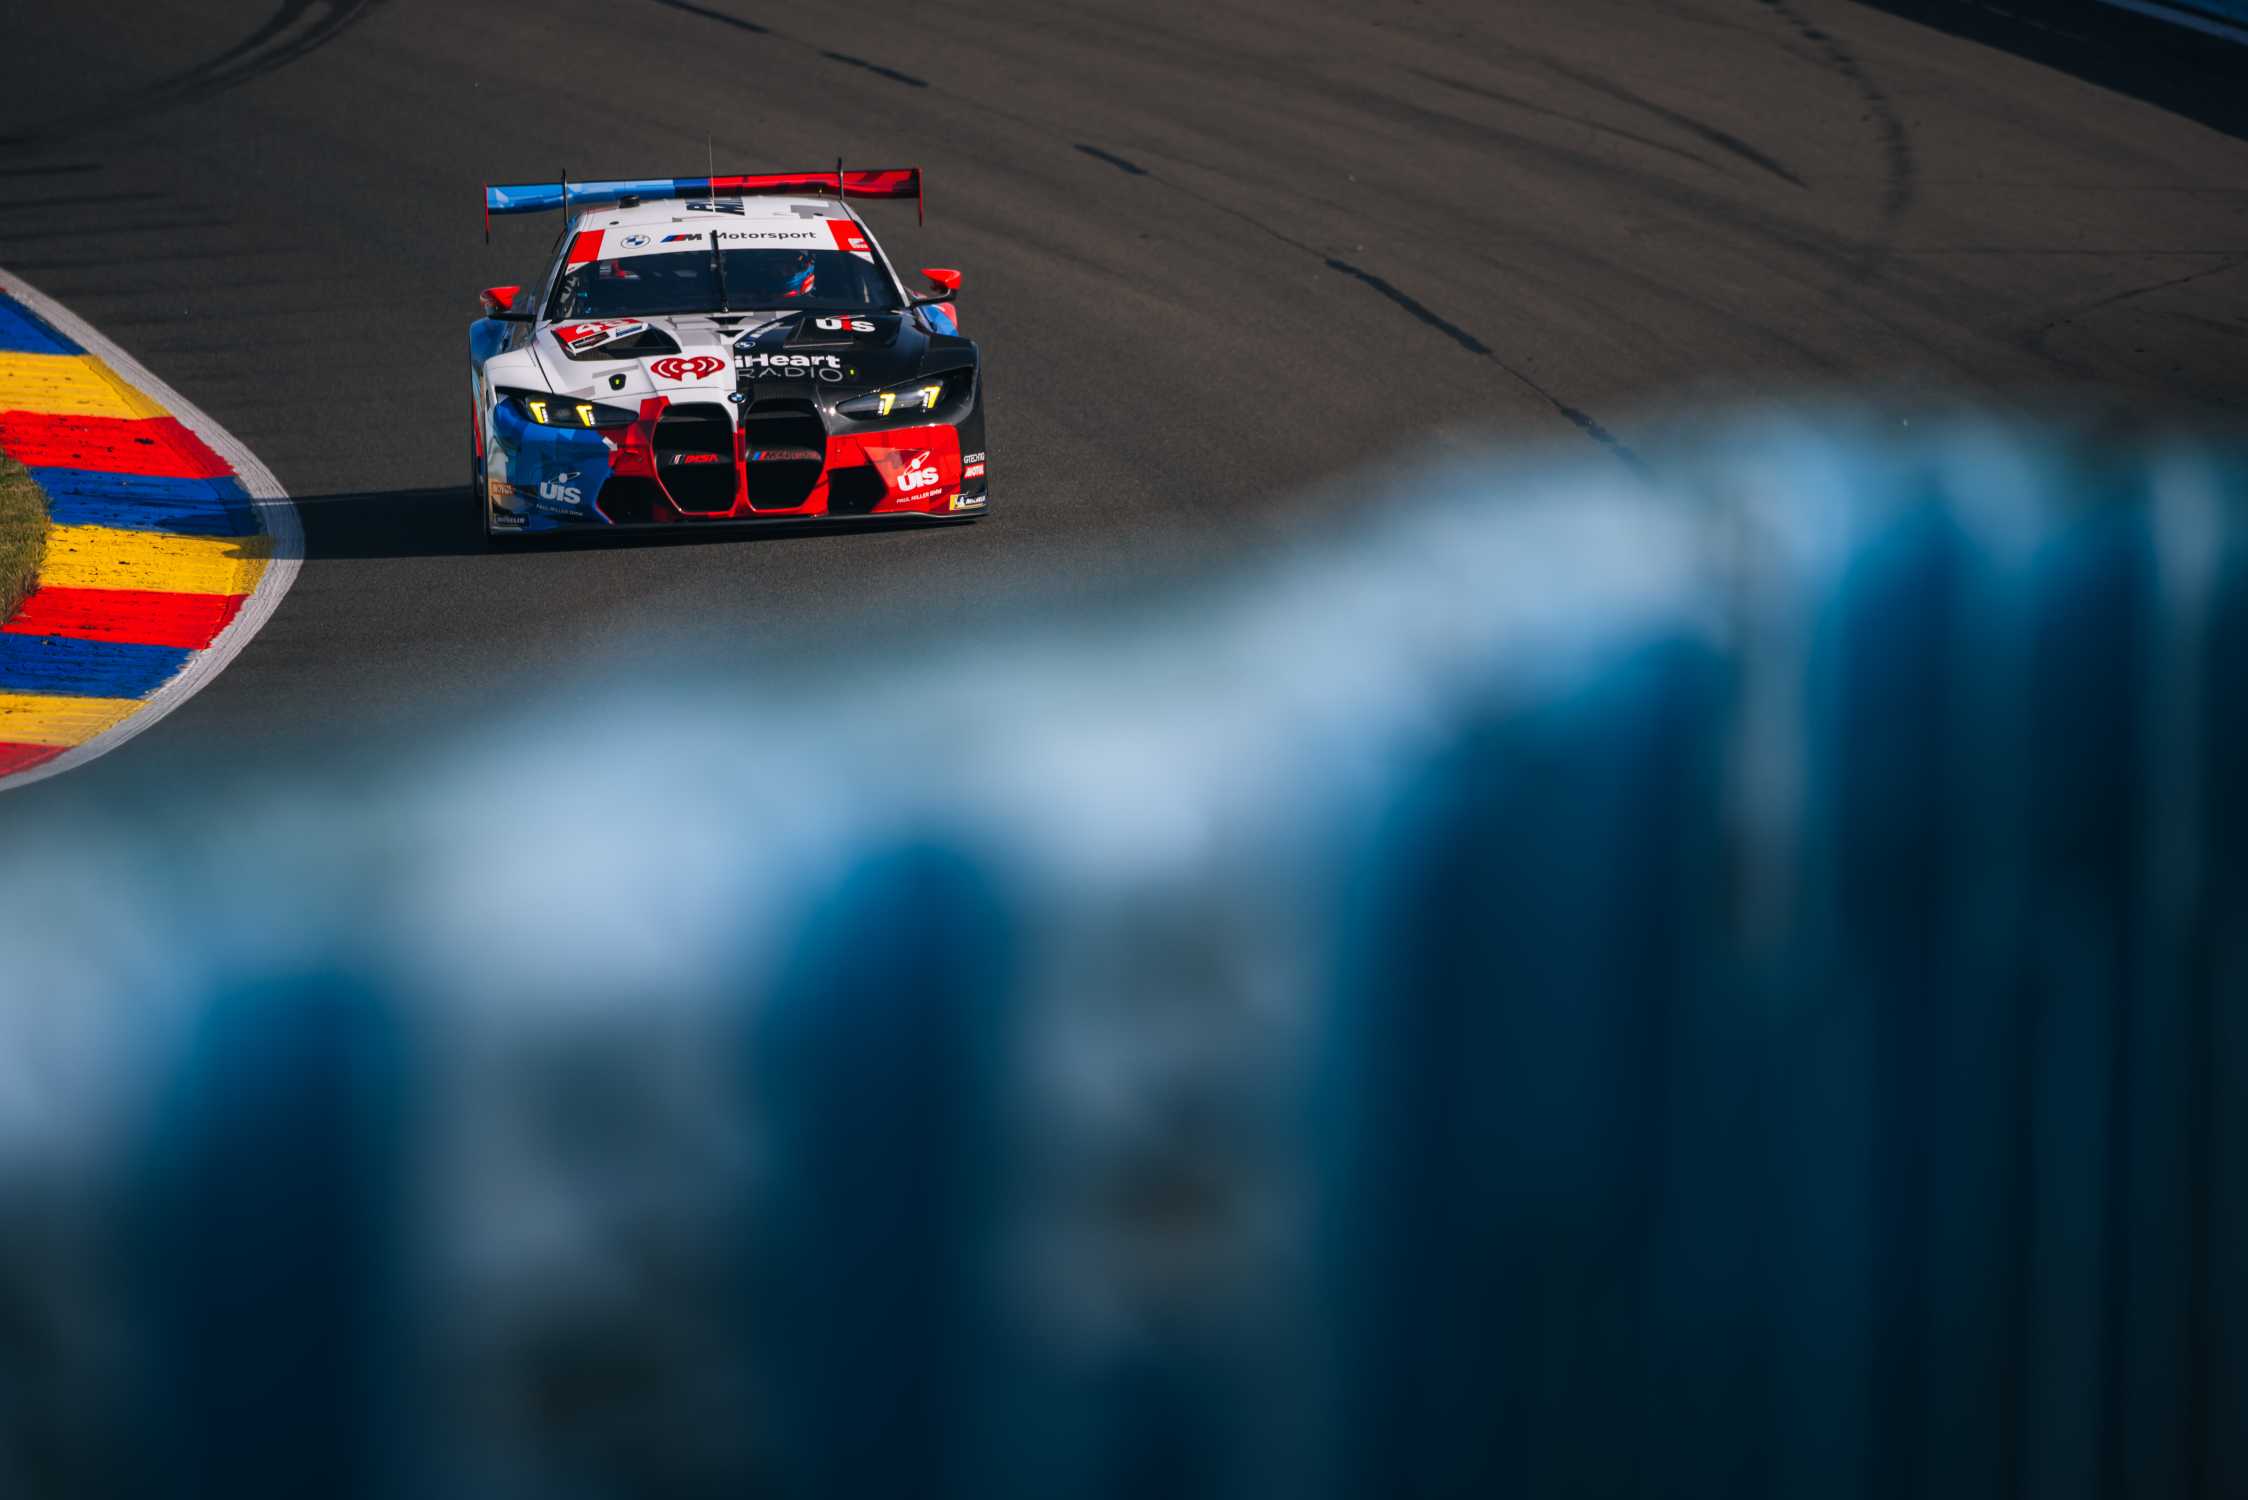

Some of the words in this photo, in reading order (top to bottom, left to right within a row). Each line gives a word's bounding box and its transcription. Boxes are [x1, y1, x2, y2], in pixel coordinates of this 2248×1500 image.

[710, 231, 817, 241] Motorsport
[734, 353, 841, 368] iHeart
[736, 367, 844, 382] RADIO
